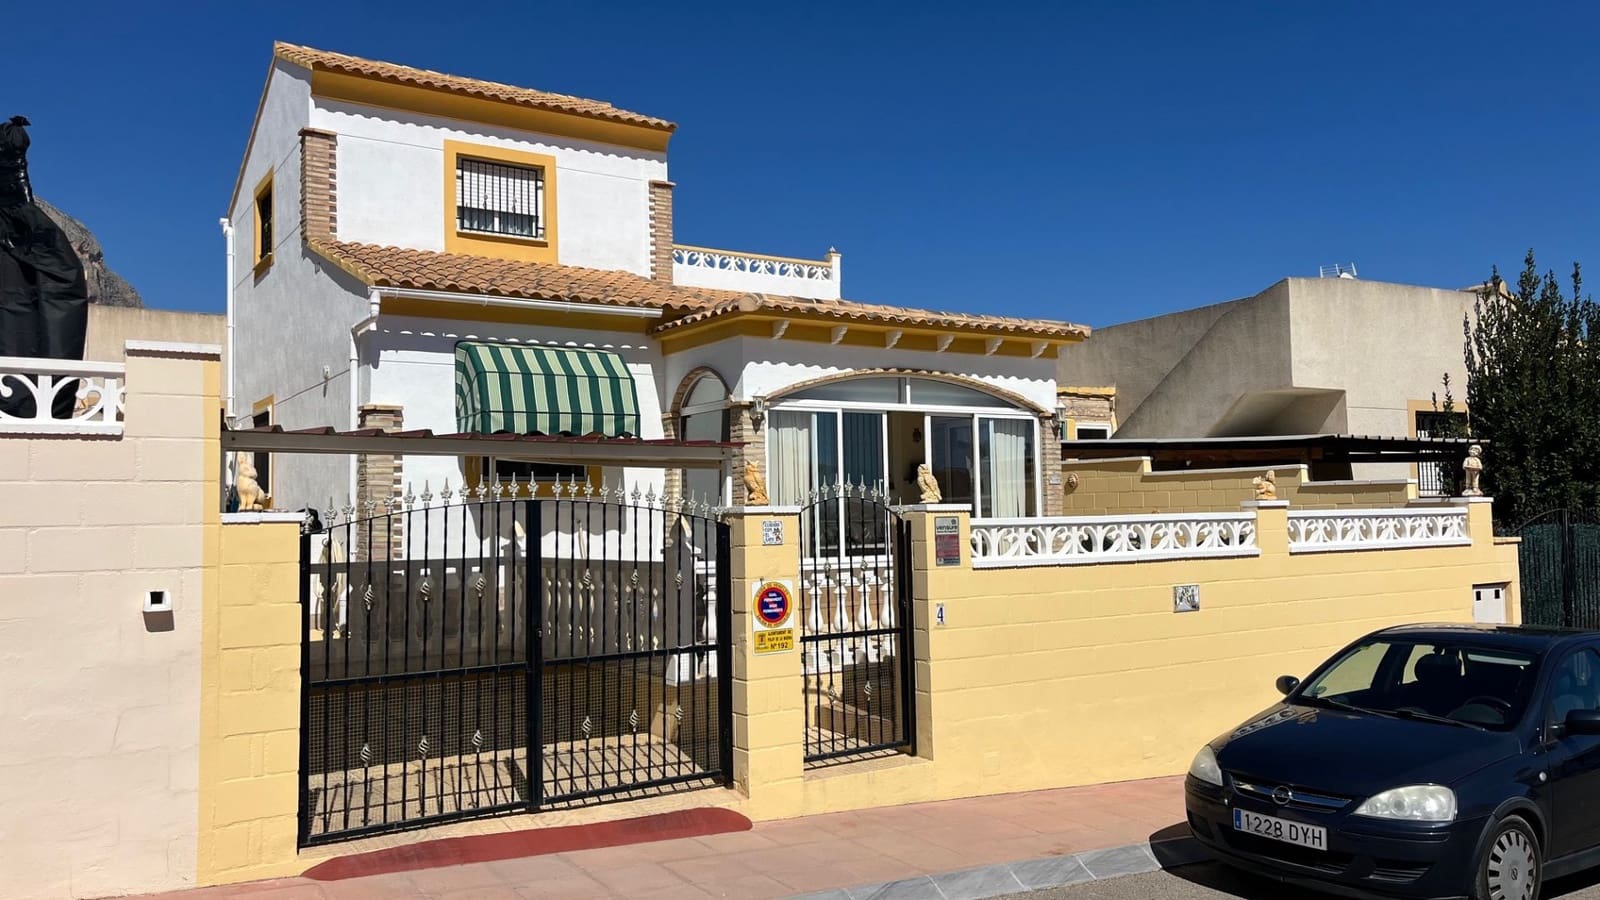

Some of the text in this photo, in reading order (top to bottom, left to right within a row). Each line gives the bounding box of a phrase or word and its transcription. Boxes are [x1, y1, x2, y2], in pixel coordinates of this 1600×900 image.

[937, 607, 944, 622] 4
[777, 641, 788, 649] 192
[1245, 813, 1322, 847] 1228 DYH
